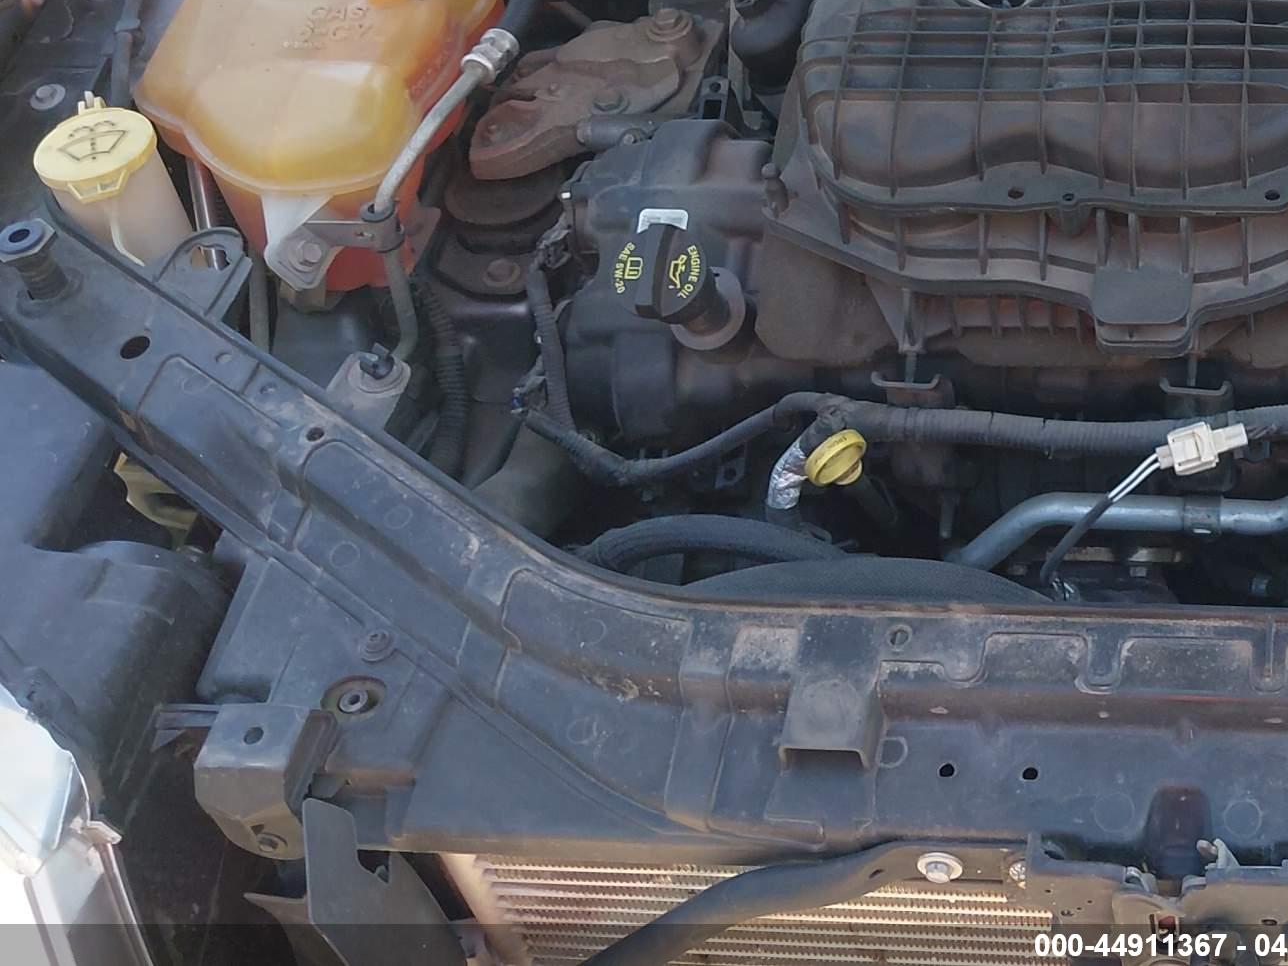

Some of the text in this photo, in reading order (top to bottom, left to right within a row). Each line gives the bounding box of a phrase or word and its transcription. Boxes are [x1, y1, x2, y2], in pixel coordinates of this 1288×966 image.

[613, 242, 636, 294] SAE 5W-20
[677, 245, 701, 299] ENGINE OIL
